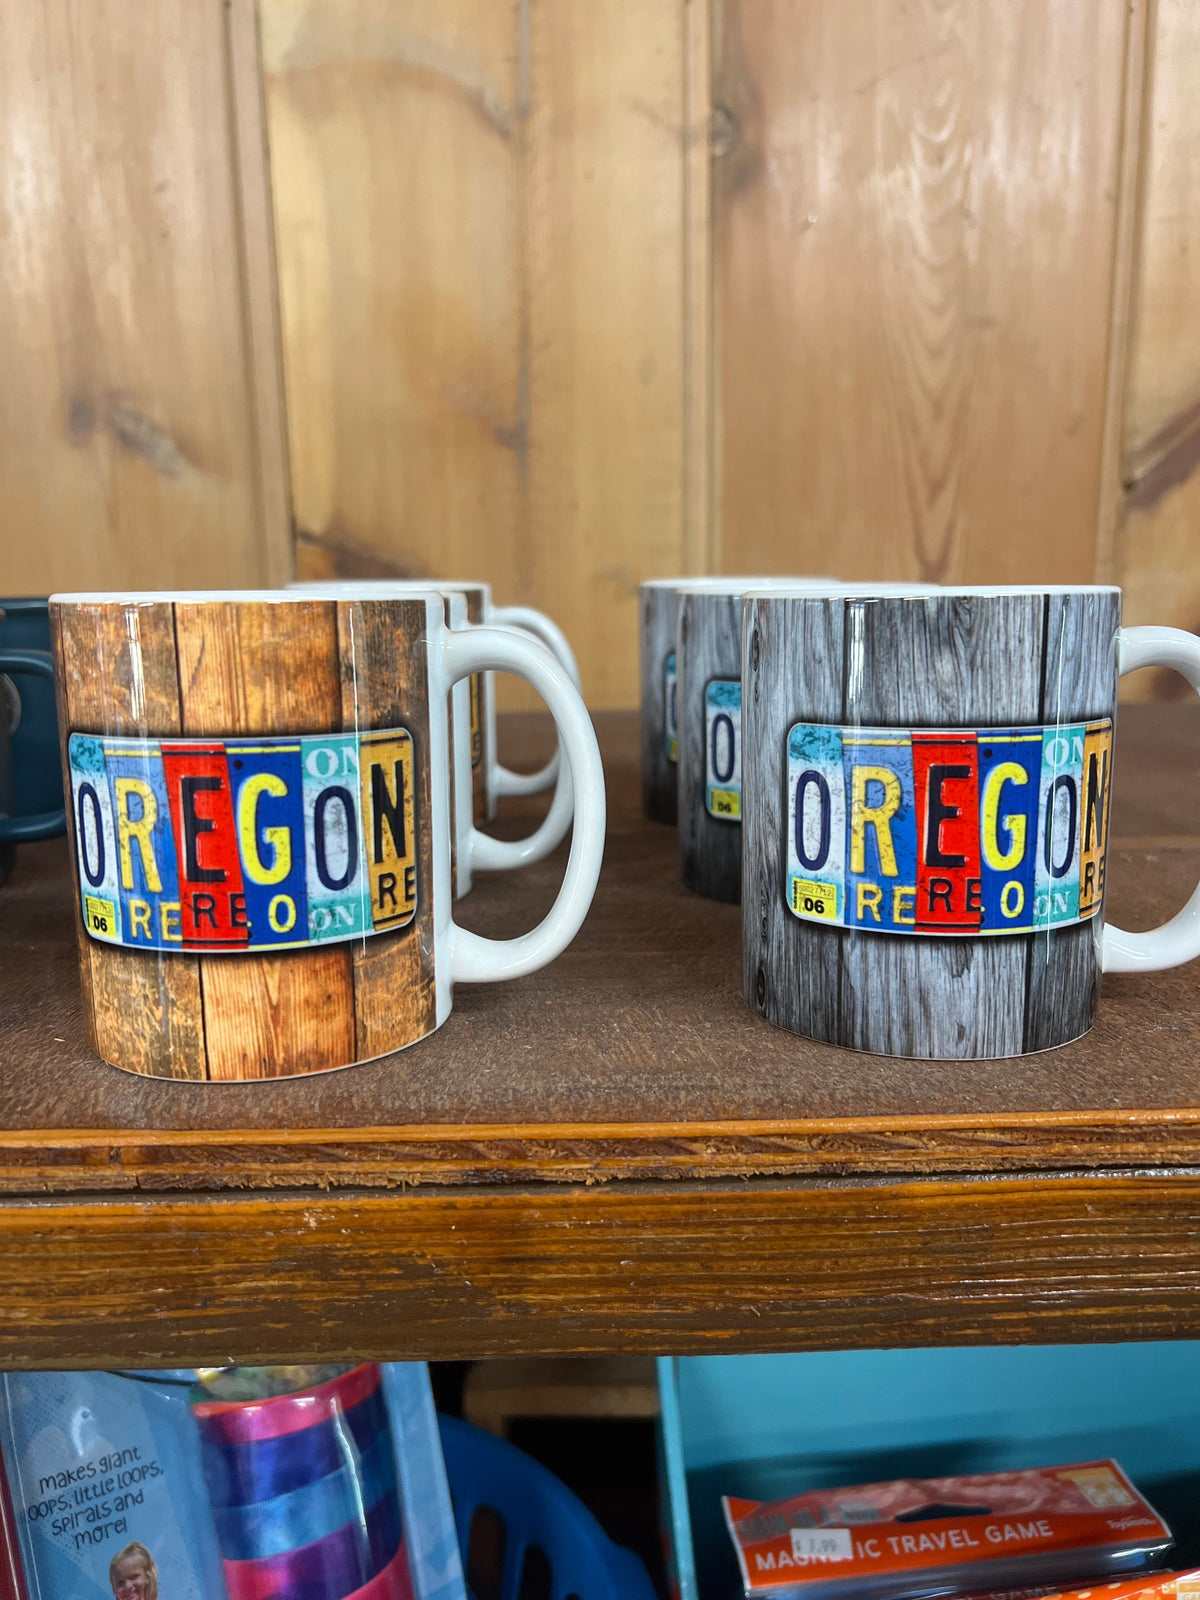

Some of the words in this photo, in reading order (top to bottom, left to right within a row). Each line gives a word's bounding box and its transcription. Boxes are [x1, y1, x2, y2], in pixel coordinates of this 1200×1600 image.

[78, 759, 406, 893] OREGON
[795, 749, 1108, 878] OREGON
[93, 915, 108, 932] 06
[804, 897, 825, 914] 06
[40, 1461, 96, 1494] makes
[99, 1447, 142, 1474] giant
[27, 1494, 72, 1523] oops,
[74, 1478, 114, 1505] little
[52, 1501, 112, 1536] spirals
[113, 1489, 144, 1512] and
[887, 1529, 980, 1555] TRAVEL
[985, 1519, 1054, 1544] GAME
